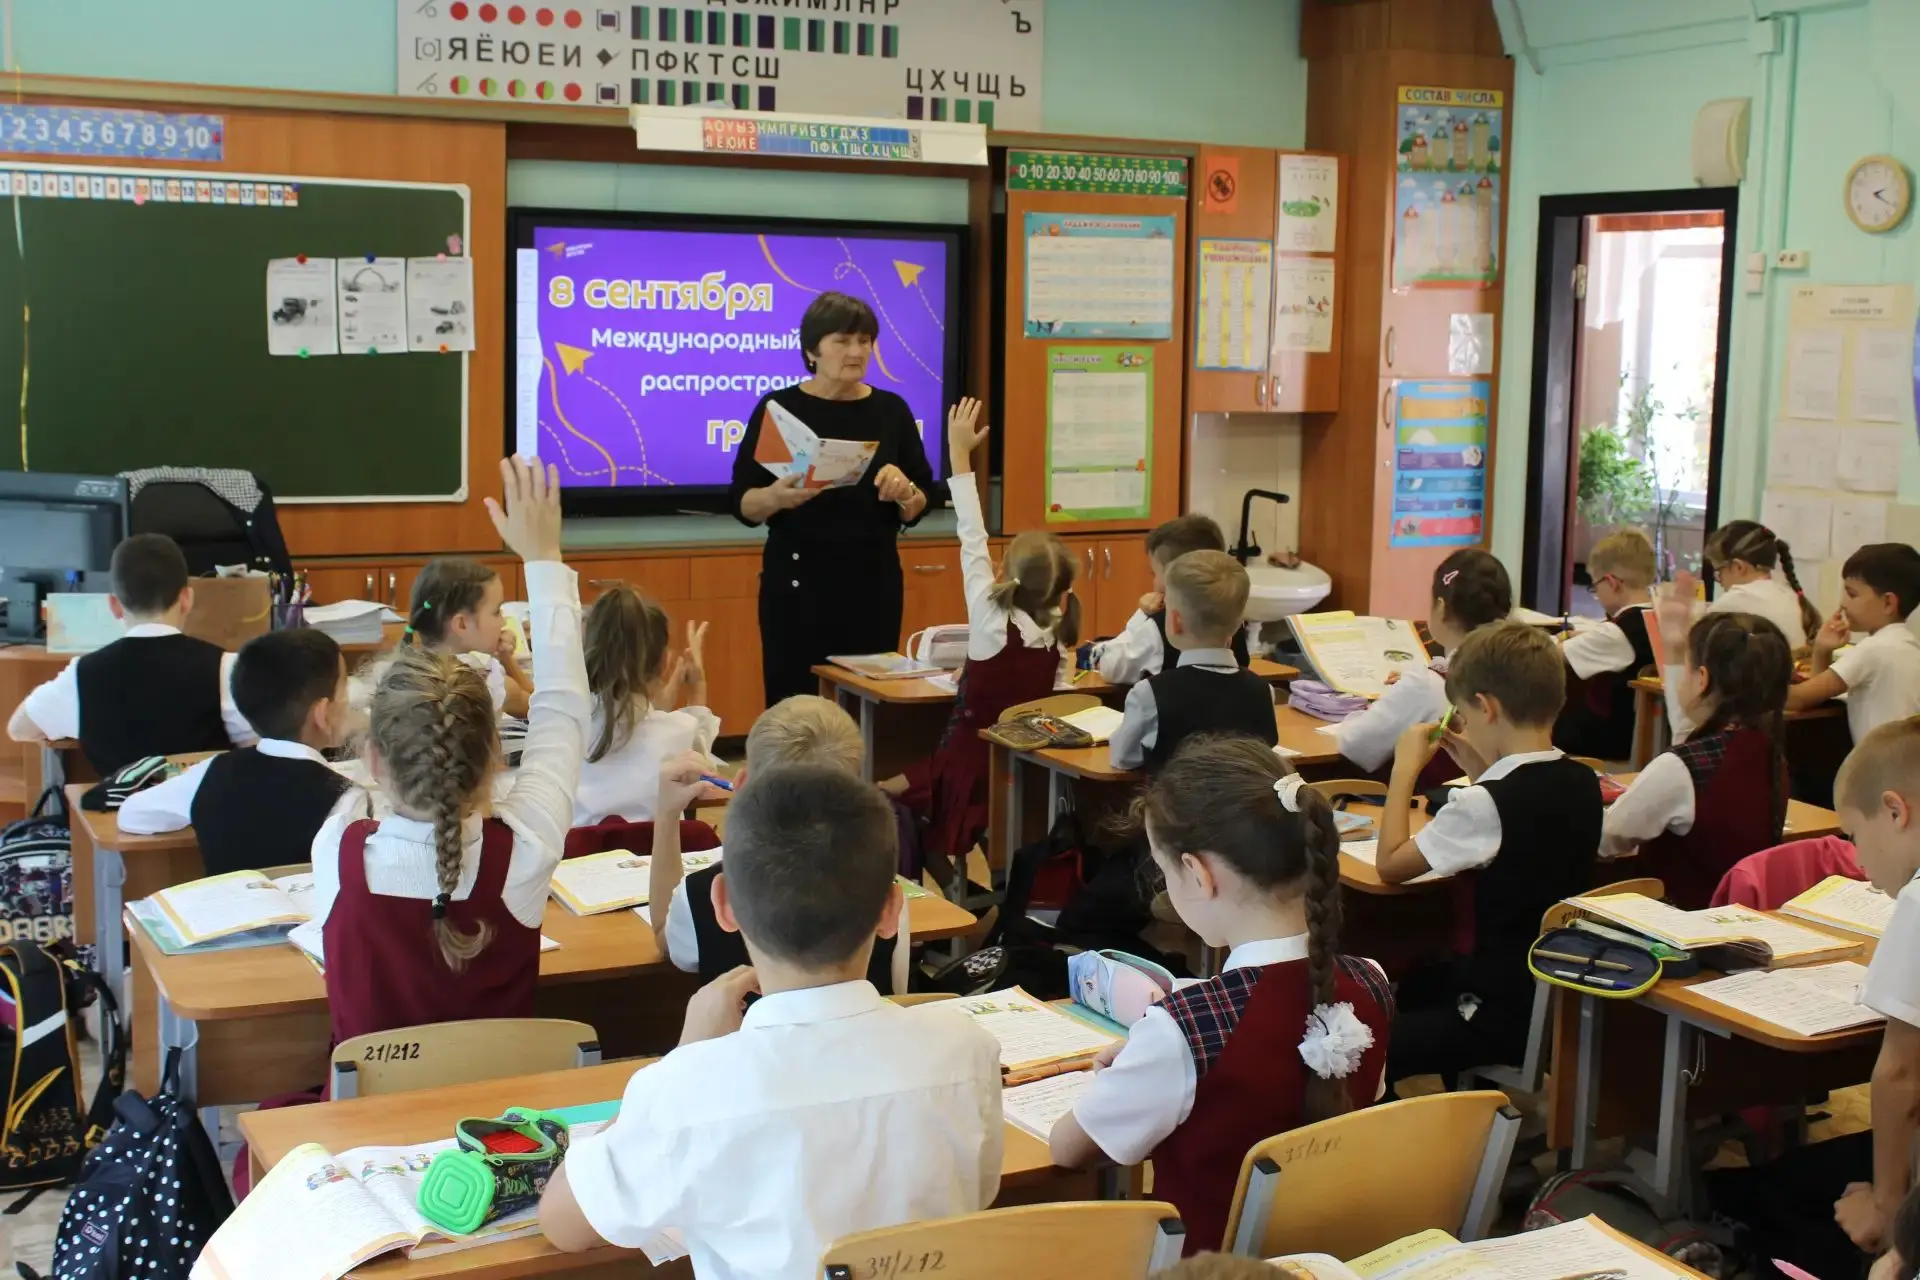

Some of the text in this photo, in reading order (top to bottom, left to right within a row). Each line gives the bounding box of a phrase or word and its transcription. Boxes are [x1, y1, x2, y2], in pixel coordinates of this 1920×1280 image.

[1011, 10, 1032, 33] Ъ
[1456, 91, 1495, 104] ЧИСЛА
[12, 117, 210, 149] 2 3 4 5 6 7 8 9 10
[1019, 164, 1180, 185] 0 10 20 30 40 50 60 70 80 90 100
[549, 270, 774, 320] 8 сентября
[591, 327, 801, 354] Международный
[364, 1042, 420, 1063] 21/212
